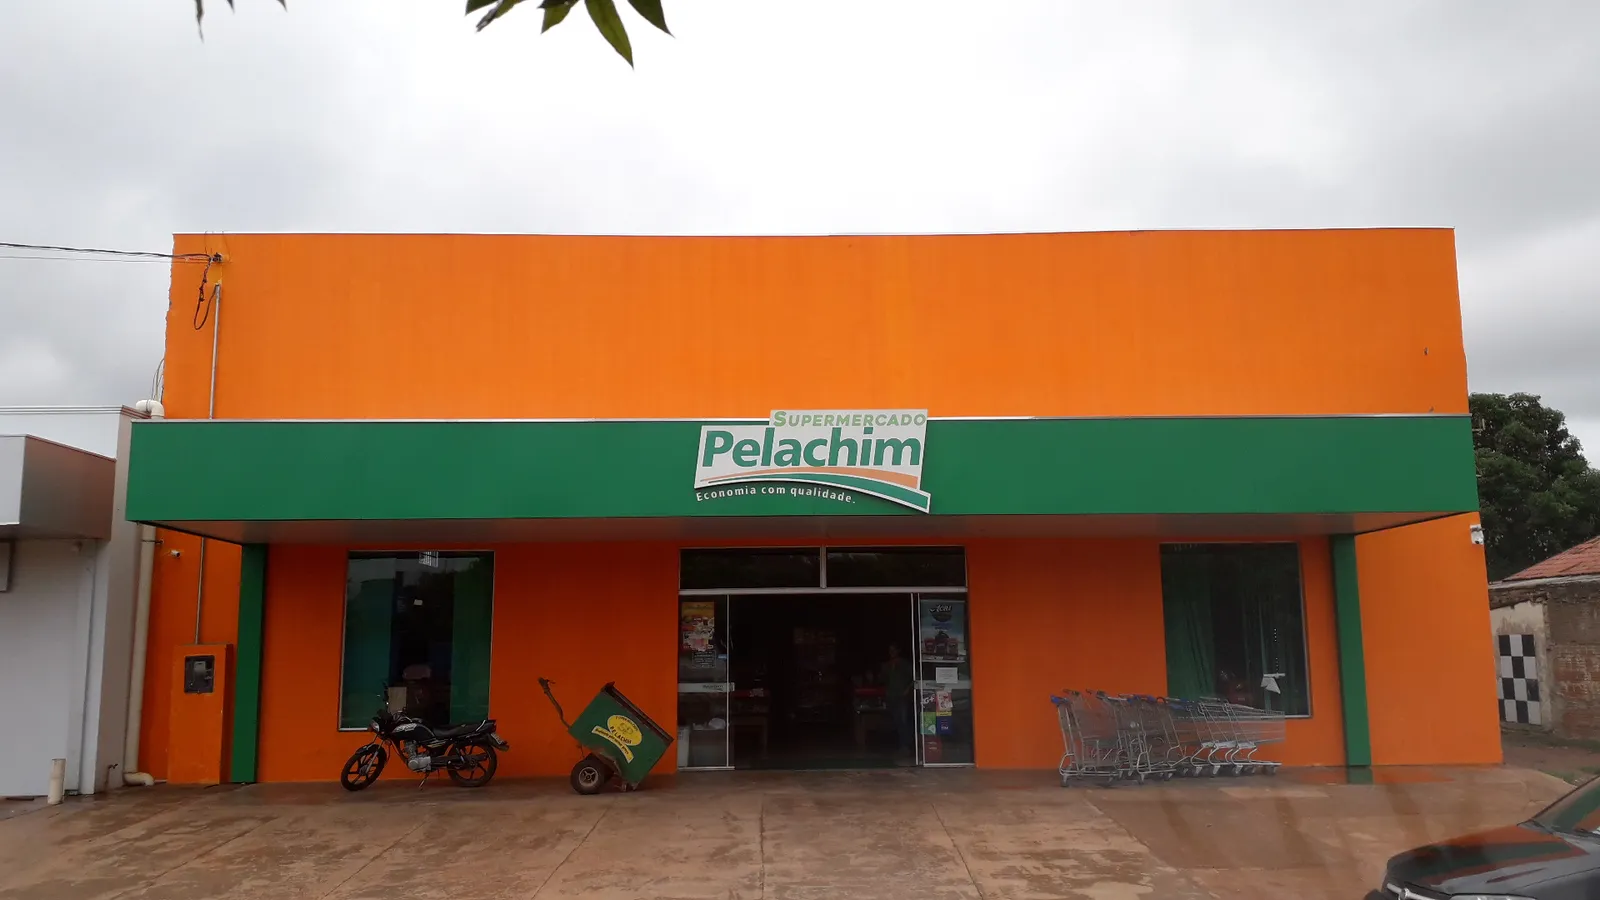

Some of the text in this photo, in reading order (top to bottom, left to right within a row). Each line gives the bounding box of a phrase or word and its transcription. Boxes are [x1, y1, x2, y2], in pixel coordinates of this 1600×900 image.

[773, 411, 926, 427] SUPERMERCADO
[702, 427, 921, 467] Pelachim
[696, 485, 856, 504] Economia com qualidade.
